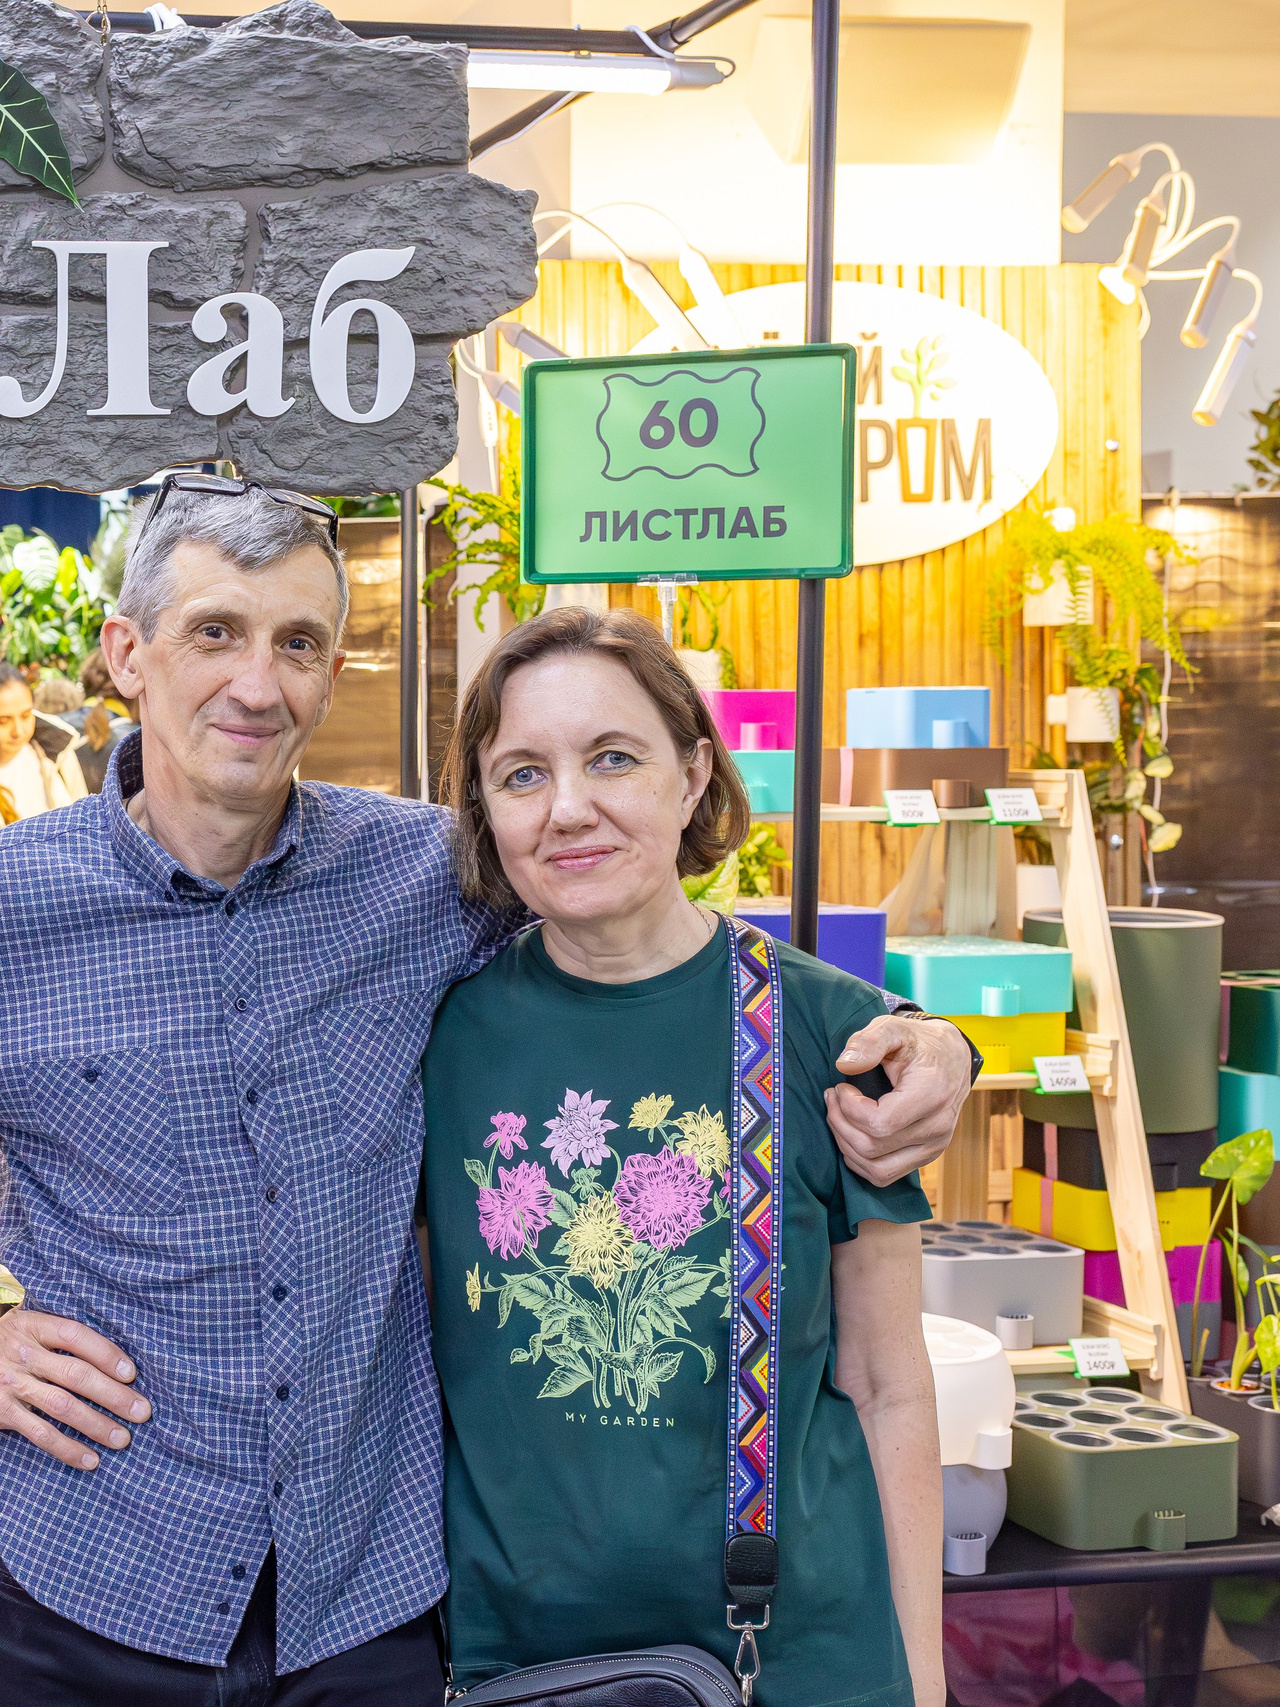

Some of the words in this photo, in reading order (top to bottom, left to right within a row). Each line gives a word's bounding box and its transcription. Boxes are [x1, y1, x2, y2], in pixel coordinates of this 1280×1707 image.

[639, 397, 719, 450] 60
[578, 504, 788, 544] ЛИСТЛАБ
[564, 1410, 587, 1424] MY
[599, 1415, 675, 1427] GARDEN
